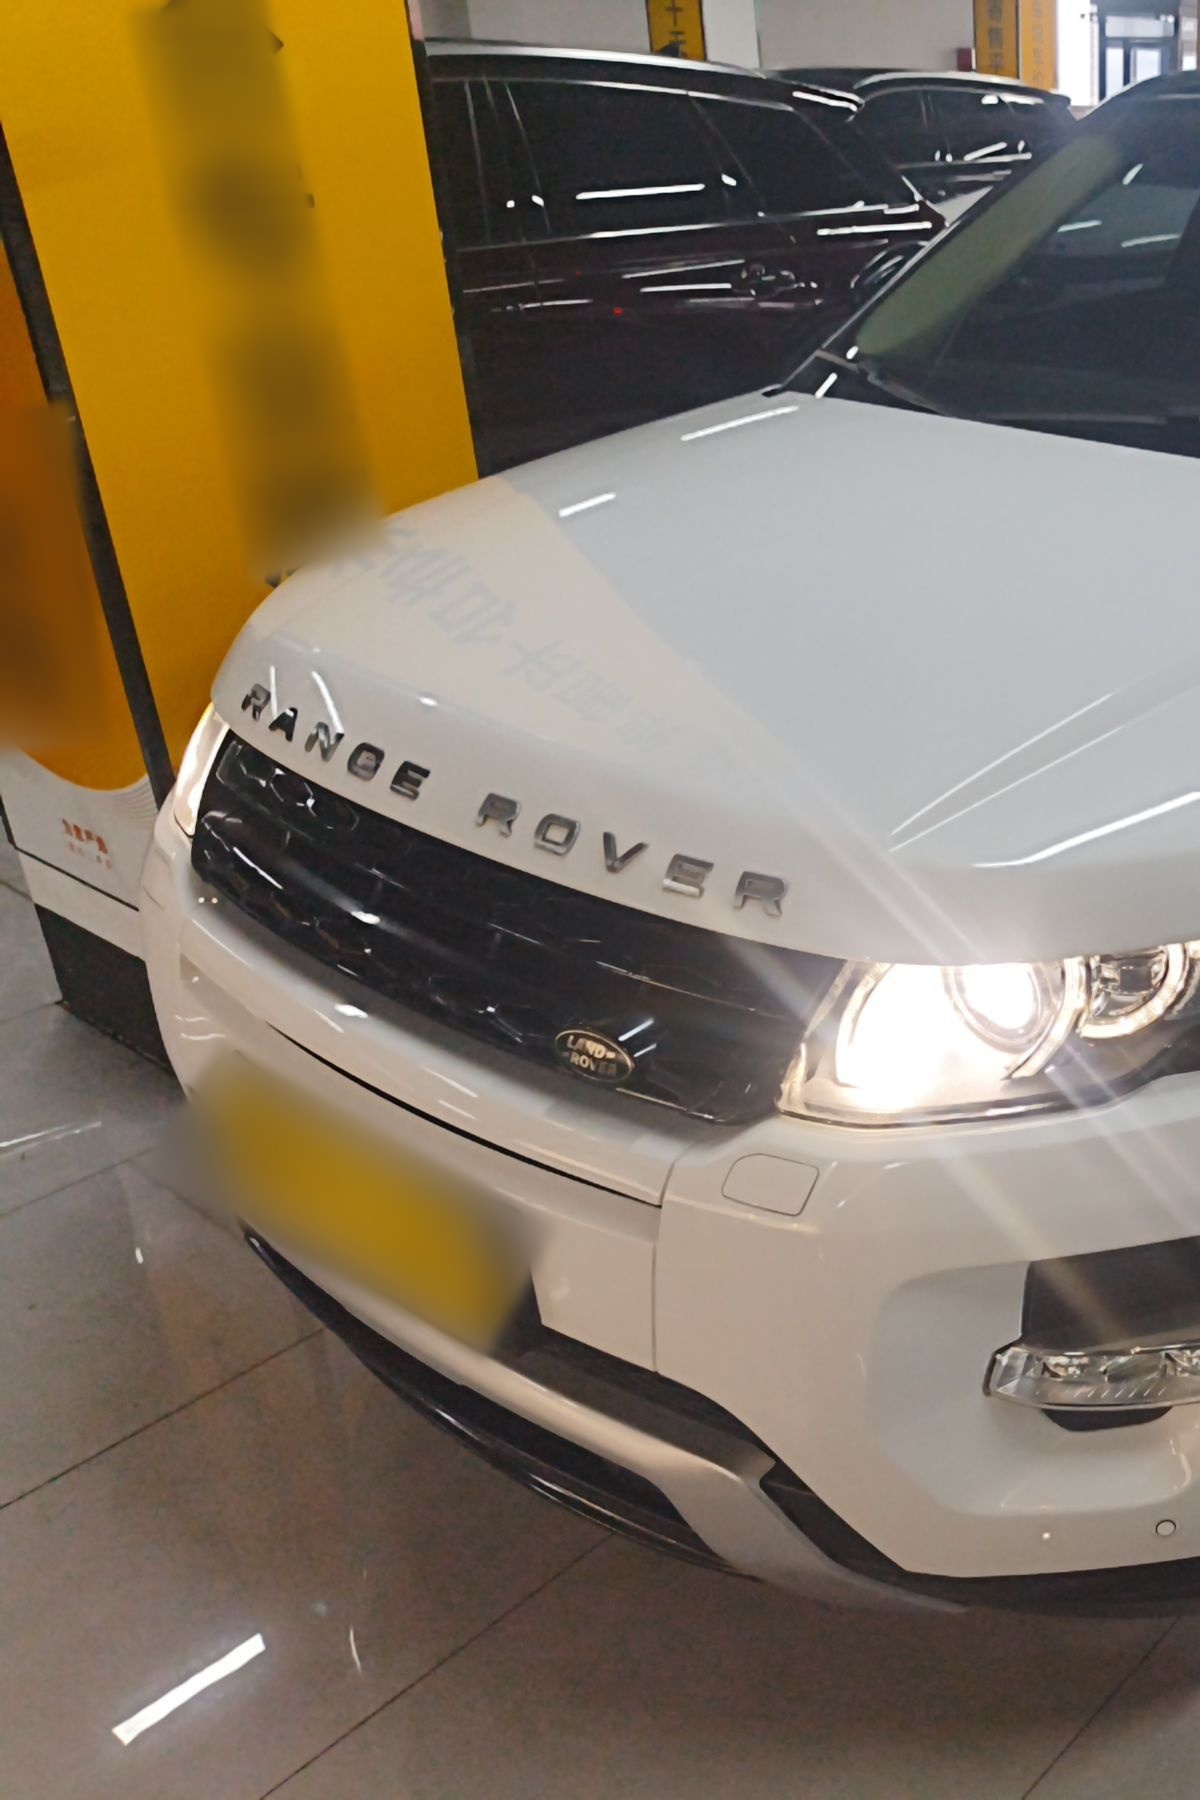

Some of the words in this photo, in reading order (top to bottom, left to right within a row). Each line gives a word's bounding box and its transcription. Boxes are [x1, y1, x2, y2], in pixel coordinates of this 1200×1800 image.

[240, 682, 431, 801] RANGE
[475, 791, 790, 918] ROVER
[566, 1034, 608, 1060] LAND
[569, 1050, 617, 1077] ROVER
